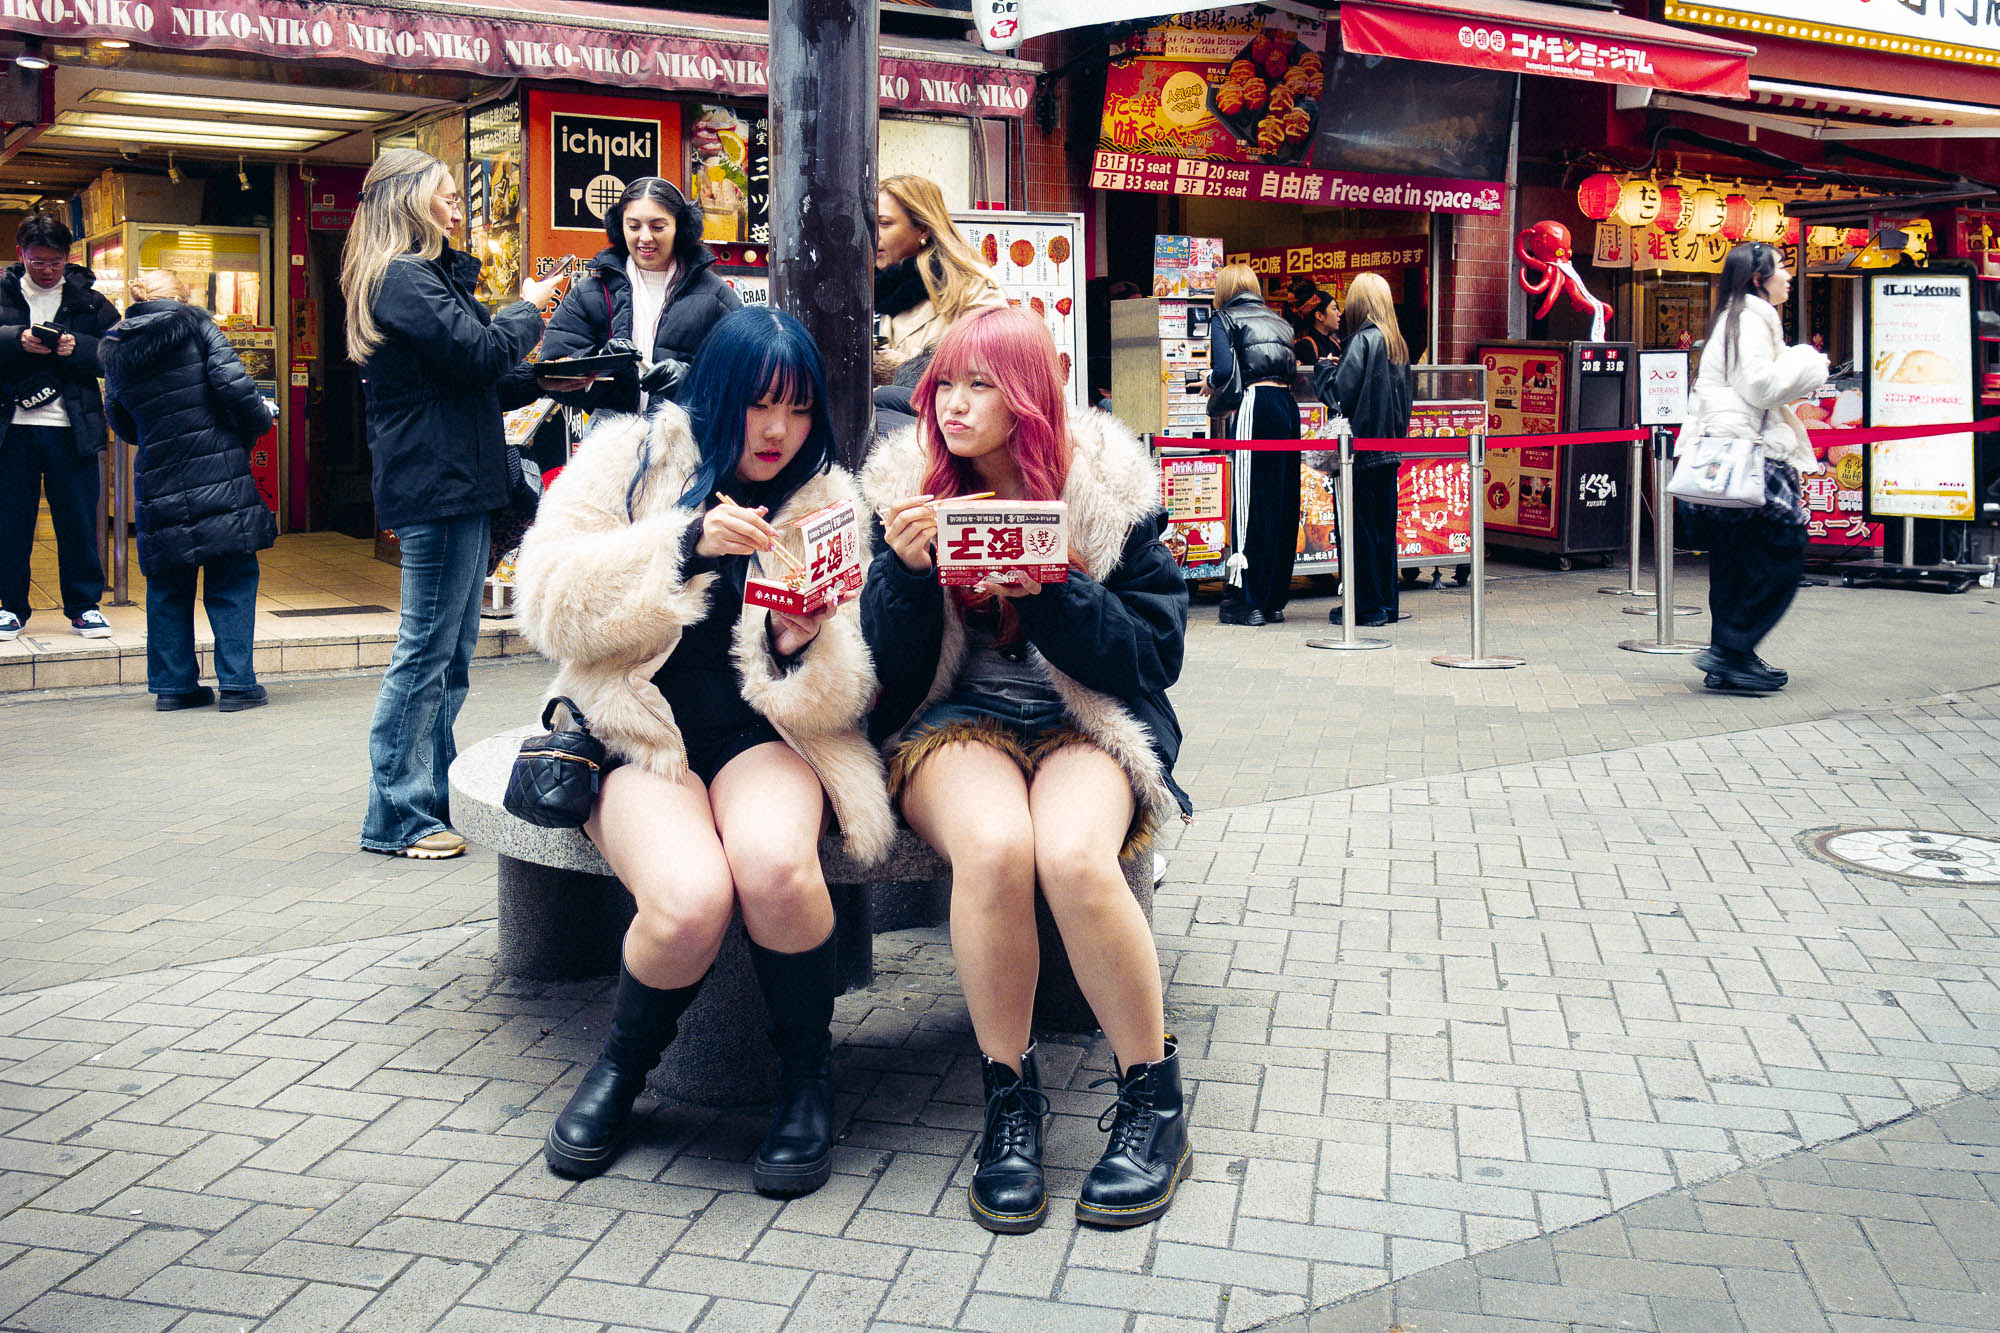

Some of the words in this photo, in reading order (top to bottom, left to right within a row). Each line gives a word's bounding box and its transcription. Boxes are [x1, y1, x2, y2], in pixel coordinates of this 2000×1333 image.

[1, 0, 155, 32] IKO-NIKO
[171, 7, 334, 47] NIKO-NIKO
[347, 23, 490, 63] NIKO-NIKO
[505, 40, 640, 75] NIKO-NIKO
[656, 51, 768, 85] NIKO-NIK
[1167, 83, 1203, 105] 人気の味
[1107, 93, 1160, 119] たこ焼
[756, 118, 768, 146] 個室
[1100, 153, 1125, 170] B1F
[1129, 157, 1145, 173] 15
[1146, 161, 1172, 175] seat
[1186, 161, 1200, 176] 1F
[1210, 164, 1225, 180] 20
[1226, 168, 1250, 183] seat
[1102, 173, 1117, 188] 2F
[1125, 174, 1142, 190] 33
[1144, 177, 1169, 192] seat
[1182, 179, 1198, 194] 3F
[1206, 182, 1222, 197] 25
[1223, 184, 1247, 199] seat
[1260, 170, 1324, 201] 自由席
[1330, 178, 1370, 203] Free
[1372, 186, 1403, 205] eat
[1404, 182, 1421, 206] in
[1422, 189, 1472, 213] space
[1639, 185, 1657, 220] たこ
[1709, 196, 1728, 229] キス
[1251, 256, 1281, 275] 20席
[1288, 249, 1313, 272] 2F
[1314, 250, 1347, 271] 33席
[1350, 248, 1424, 269] 自由席あります
[742, 289, 767, 305] CRAB
[1582, 360, 1601, 372] 20席
[1606, 360, 1625, 372] 33席
[1584, 351, 1592, 359] 1F
[1607, 351, 1617, 359] 2F
[1650, 369, 1678, 381] 入口
[21, 387, 56, 408] BALR.
[1648, 386, 1680, 395] ENTRANCE
[1171, 462, 1194, 474] Drink
[1194, 461, 1217, 474] Menu
[947, 527, 1025, 561] 餃子
